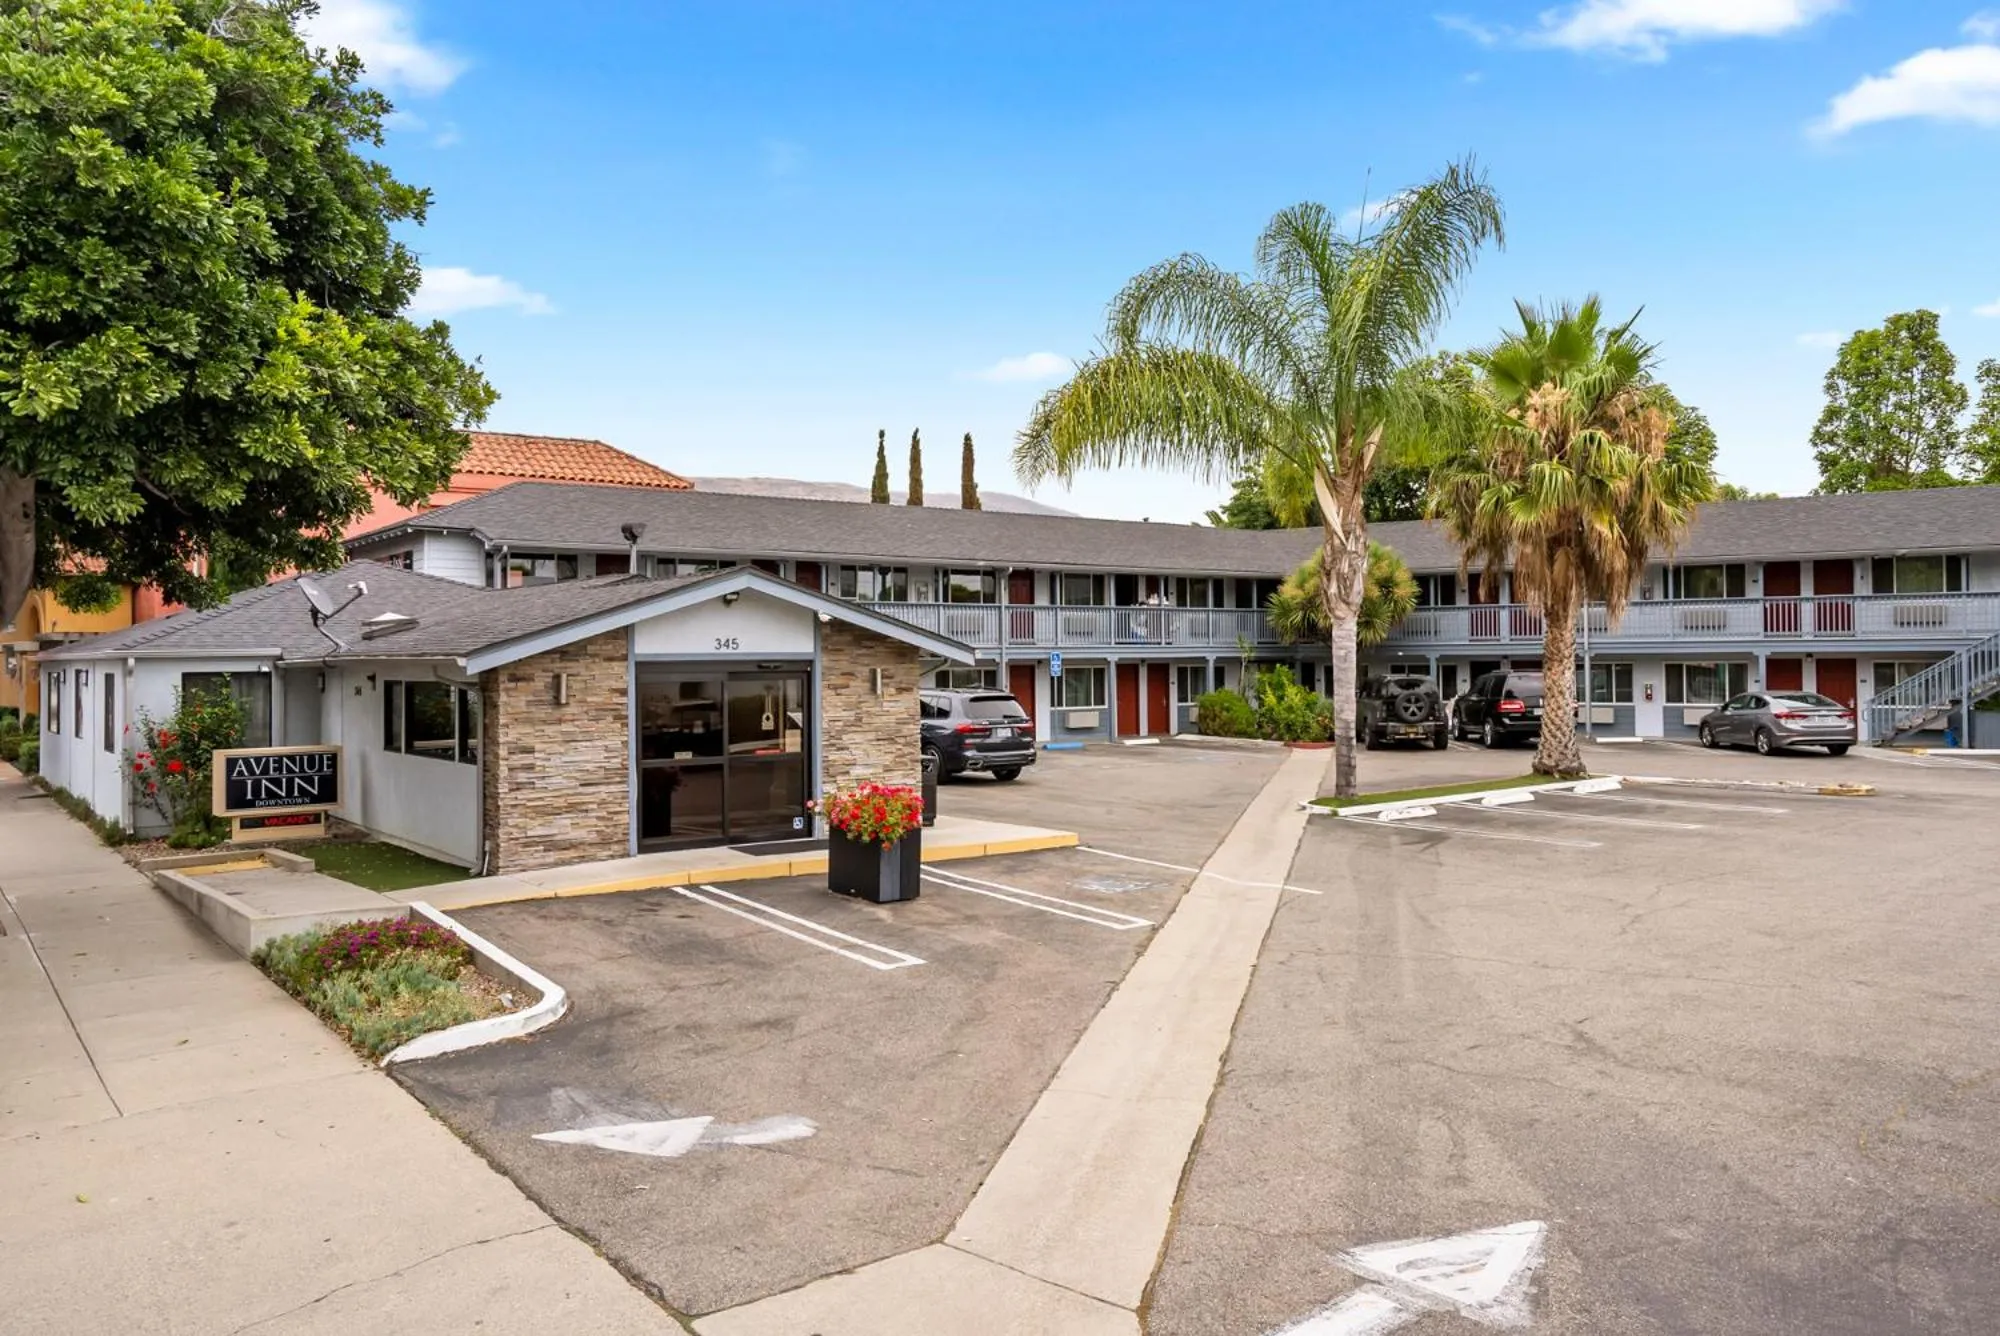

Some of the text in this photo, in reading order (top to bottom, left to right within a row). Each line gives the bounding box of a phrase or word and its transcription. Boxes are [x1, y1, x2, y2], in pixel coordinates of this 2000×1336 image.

[714, 638, 740, 650] 345
[233, 755, 333, 776] AVENUE
[246, 776, 319, 800] INN
[255, 798, 311, 807] DOWNTOWN
